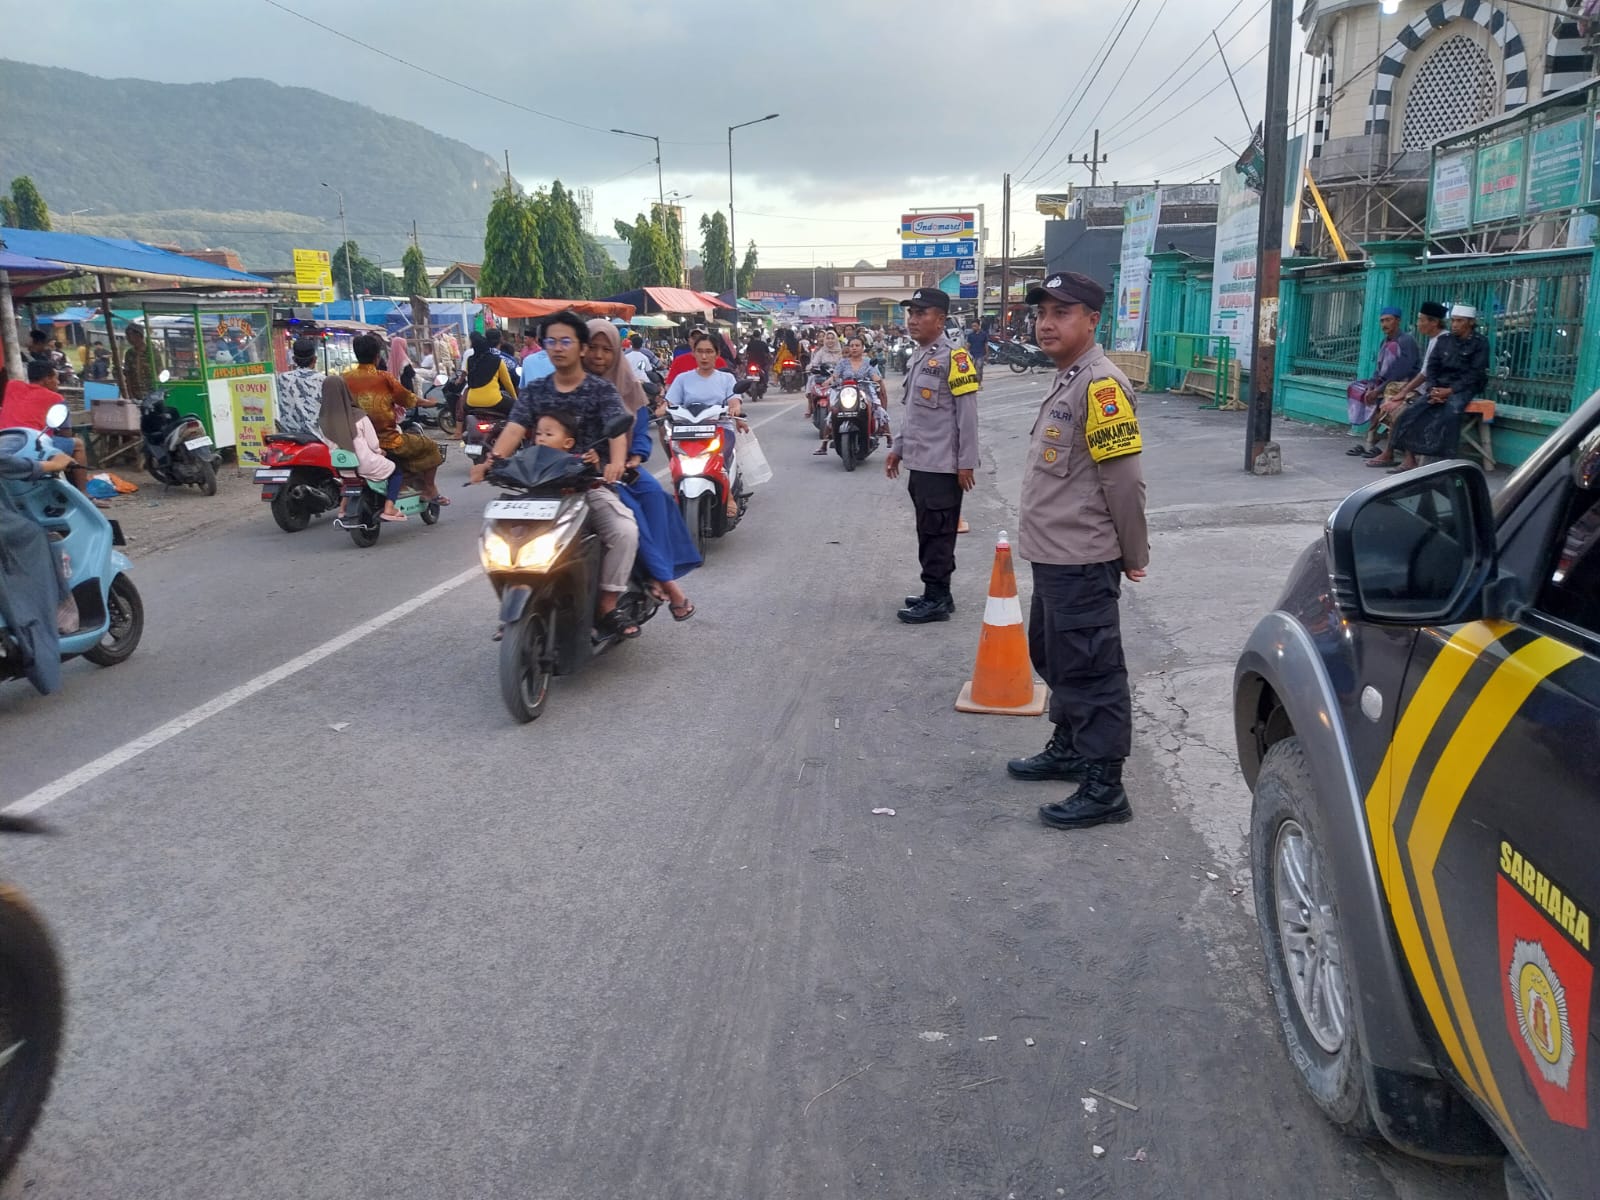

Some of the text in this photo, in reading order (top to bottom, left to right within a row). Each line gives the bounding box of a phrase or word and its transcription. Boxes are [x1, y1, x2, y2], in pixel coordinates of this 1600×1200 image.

[914, 221, 961, 231] Indomaret
[1049, 409, 1073, 421] POLRI
[1500, 840, 1590, 952] SABHARA
